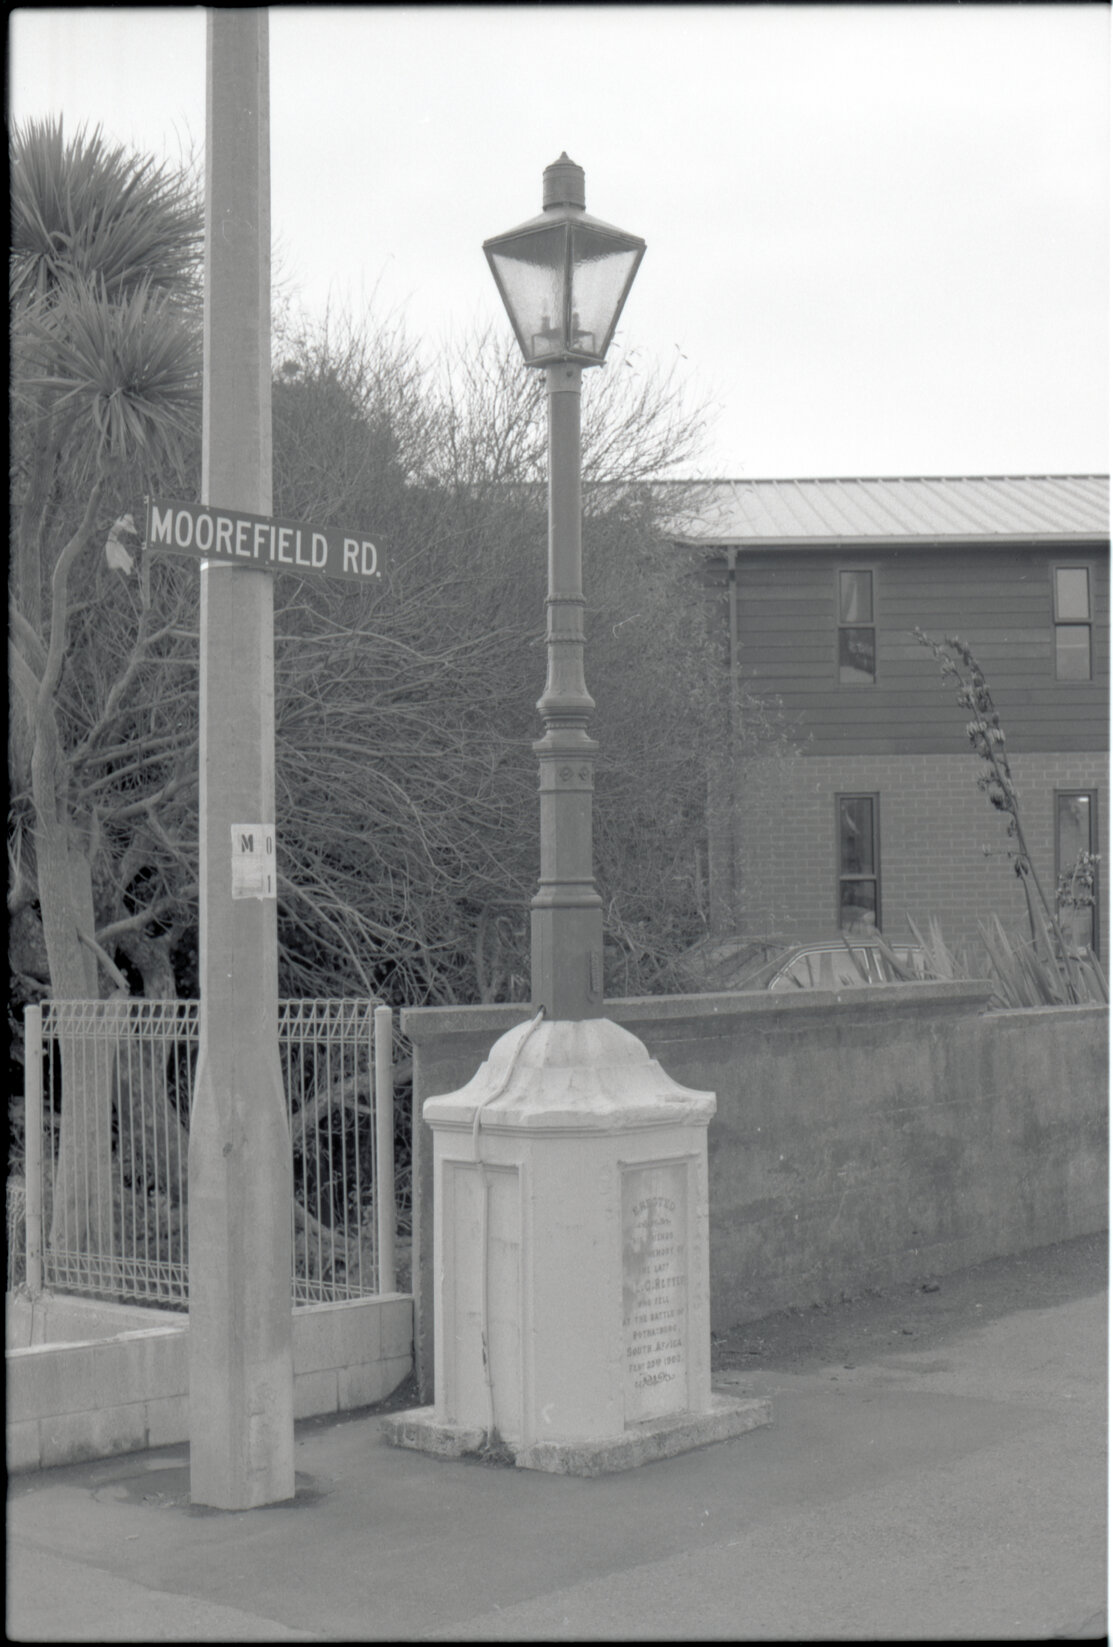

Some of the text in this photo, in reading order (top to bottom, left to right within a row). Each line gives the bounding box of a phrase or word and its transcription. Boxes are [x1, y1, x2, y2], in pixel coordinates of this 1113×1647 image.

[151, 506, 381, 577] MOOREFIELD RD.
[241, 834, 254, 853] M
[650, 1309, 675, 1321] BATTLE
[626, 1339, 682, 1357] SOUTH AFRICA
